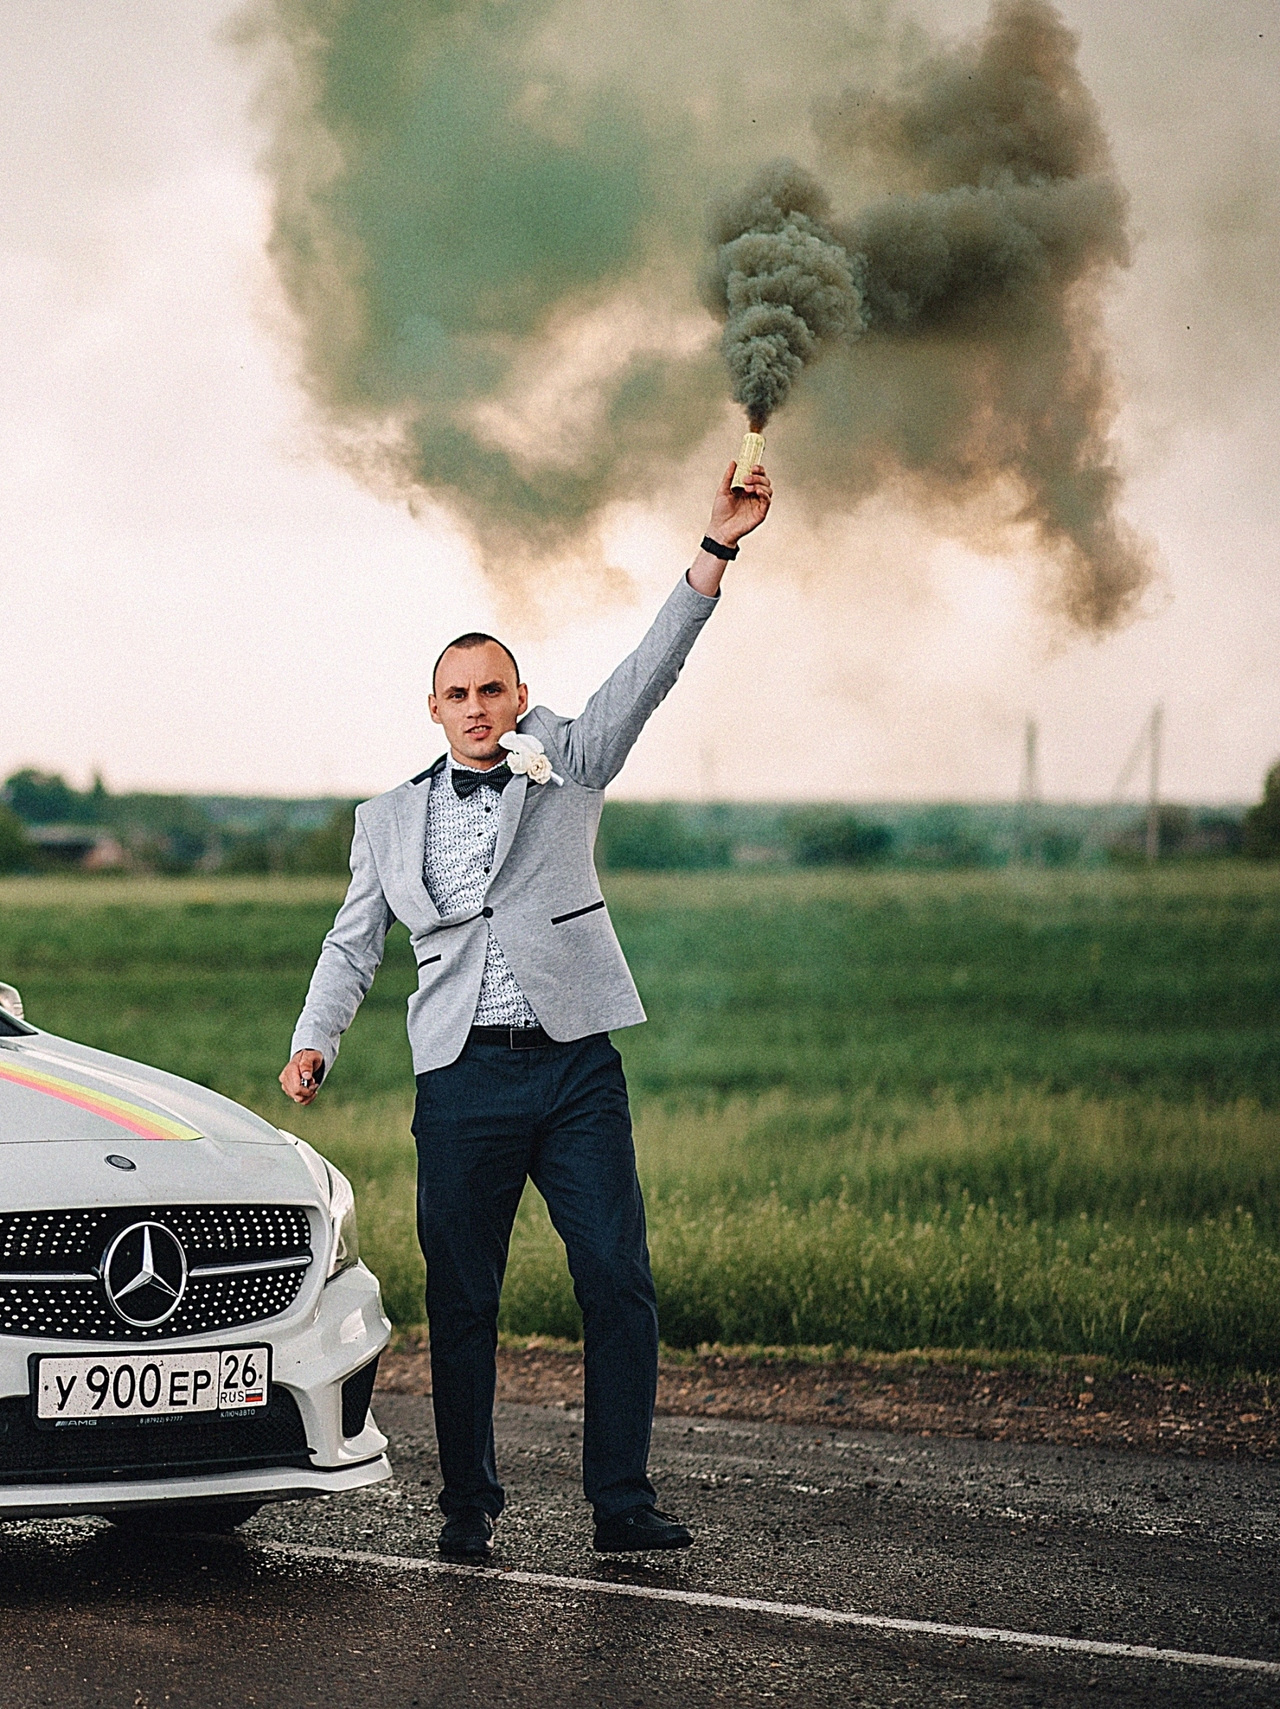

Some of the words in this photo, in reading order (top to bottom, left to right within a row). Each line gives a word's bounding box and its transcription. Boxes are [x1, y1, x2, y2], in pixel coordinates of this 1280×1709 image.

[86, 1363, 161, 1410] 900
[223, 1354, 257, 1389] 26
[220, 1390, 245, 1404] RUS
